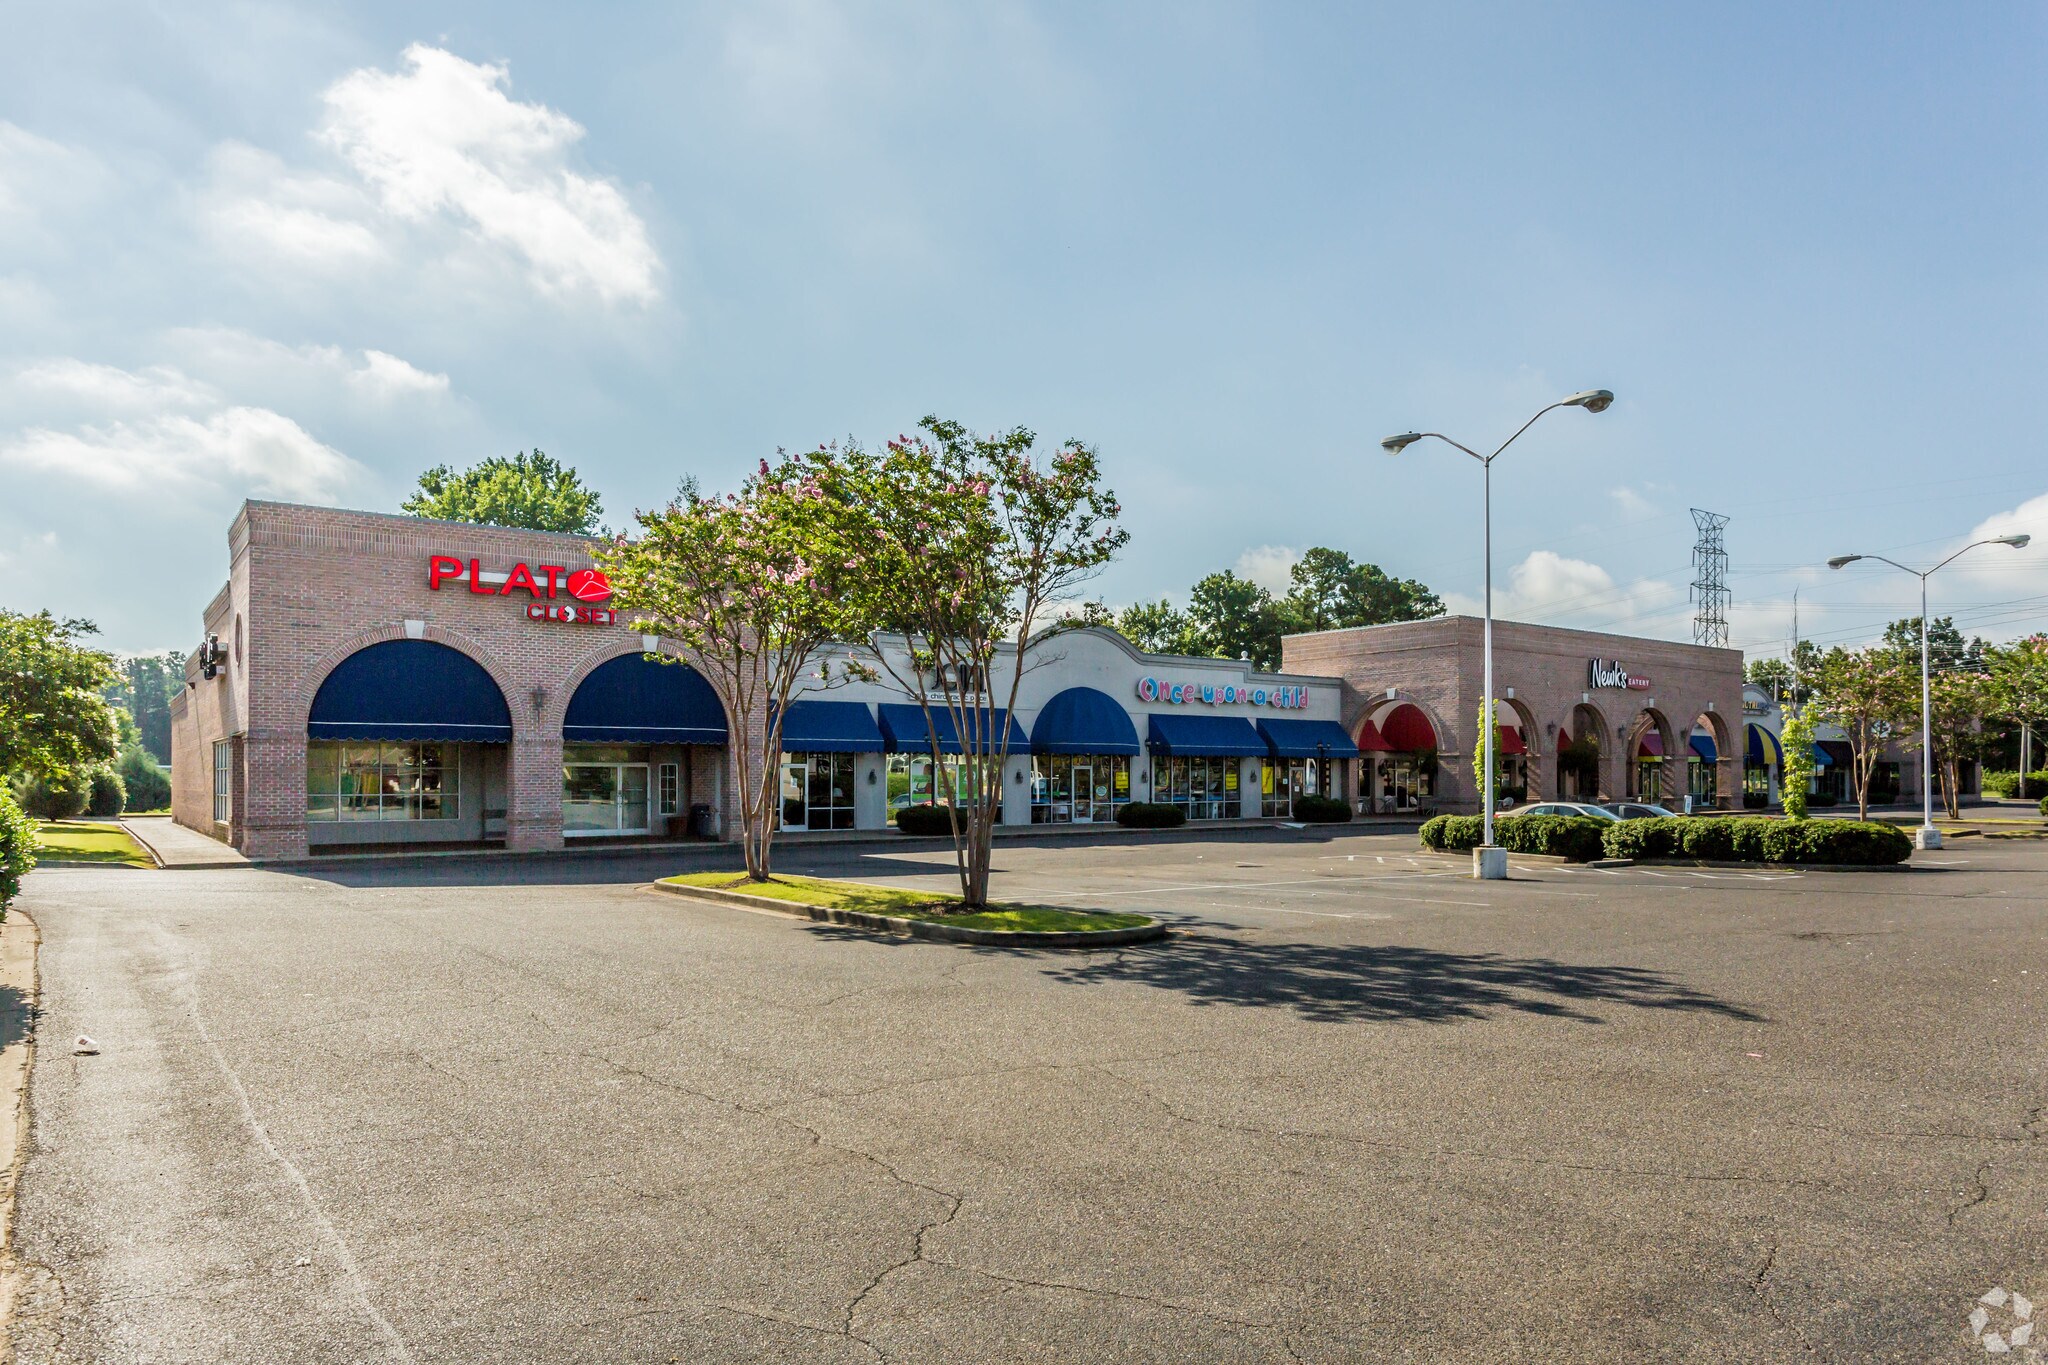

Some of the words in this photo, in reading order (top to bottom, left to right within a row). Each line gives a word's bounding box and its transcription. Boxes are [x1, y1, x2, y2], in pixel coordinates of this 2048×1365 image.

[527, 603, 619, 626] CLOSET
[1590, 658, 1627, 690] Newk's
[1628, 678, 1650, 687] EATERY
[1138, 676, 1196, 705] Once
[1202, 684, 1248, 708] upon
[1252, 688, 1267, 706] a
[1271, 685, 1310, 709] child
